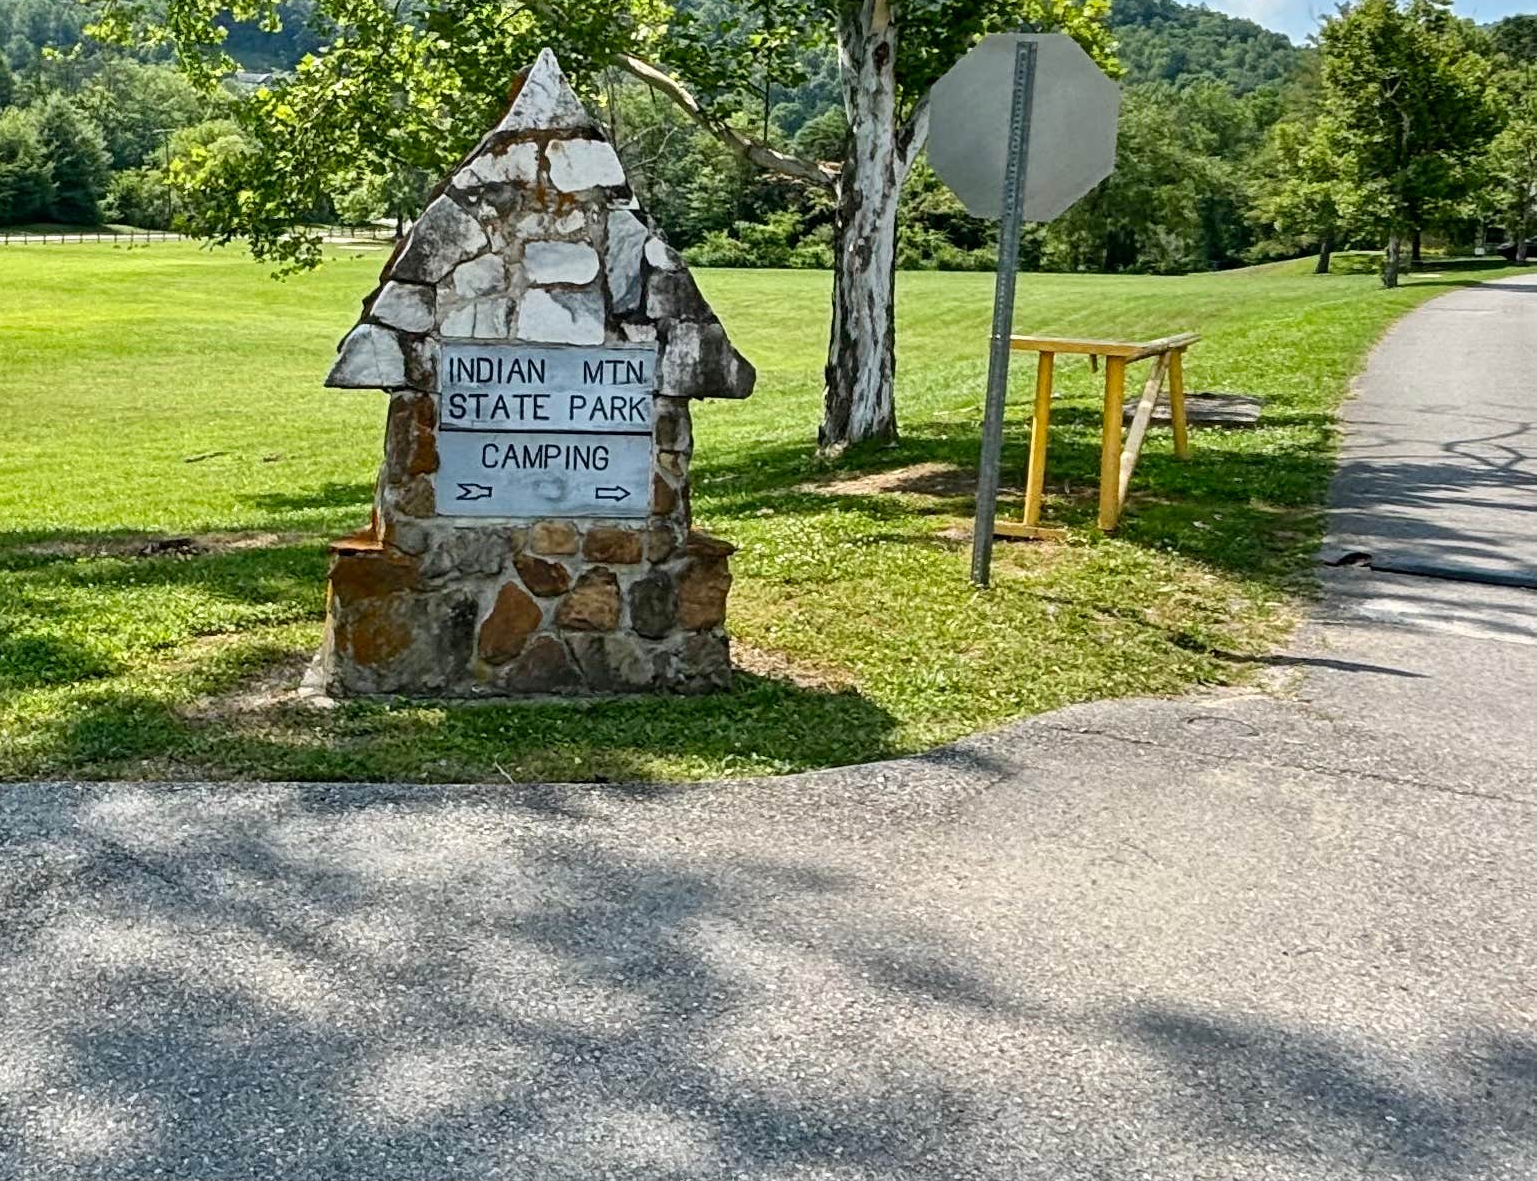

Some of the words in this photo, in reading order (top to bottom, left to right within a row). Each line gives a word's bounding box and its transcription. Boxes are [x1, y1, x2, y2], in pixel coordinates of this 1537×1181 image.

[448, 357, 546, 384] INDIAN
[583, 359, 645, 385] MTN
[448, 393, 551, 420] STATE
[569, 395, 647, 422] PARK
[481, 443, 610, 471] CAMPING
